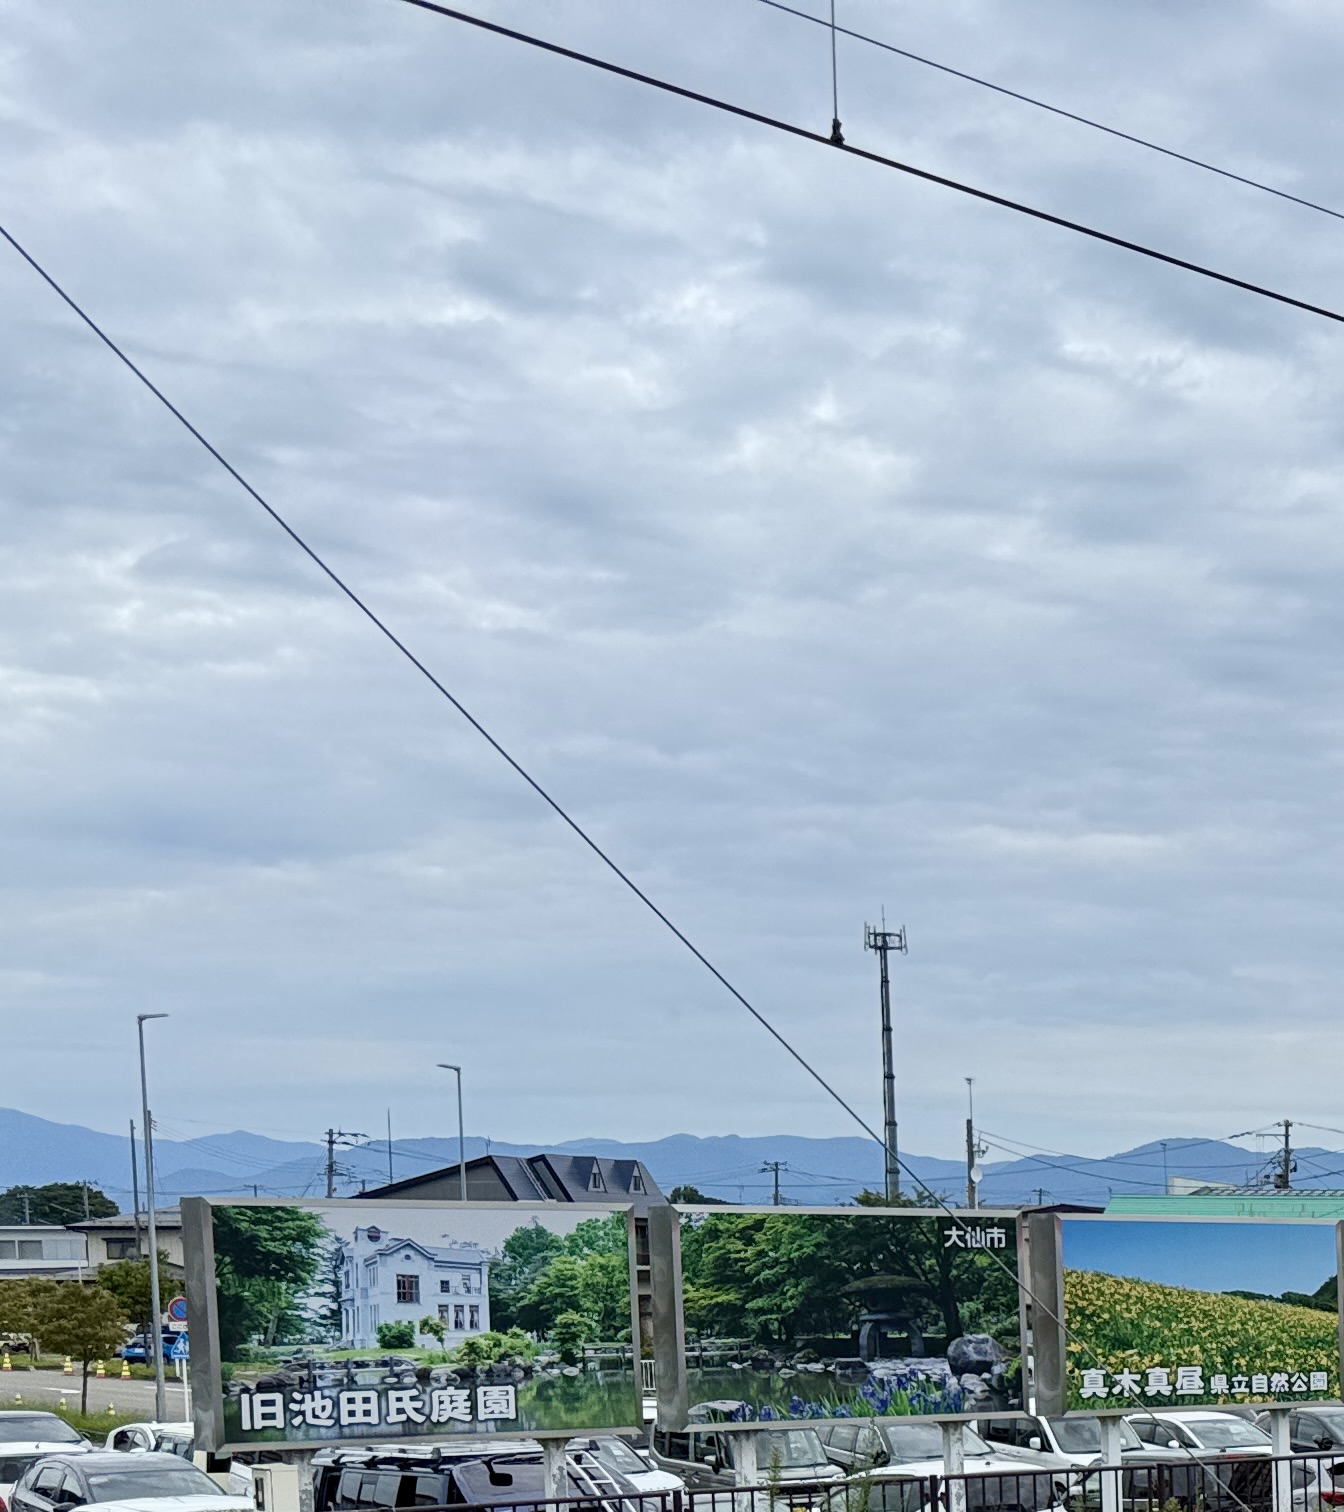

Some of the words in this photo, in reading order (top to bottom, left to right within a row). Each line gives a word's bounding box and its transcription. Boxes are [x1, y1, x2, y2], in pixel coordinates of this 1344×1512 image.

[944, 1226, 1006, 1248] 大仙市
[1079, 1366, 1205, 1398] 真木真昼
[1210, 1371, 1328, 1395] 県立自然公園
[241, 1384, 515, 1430] 旧池田氏庭園
